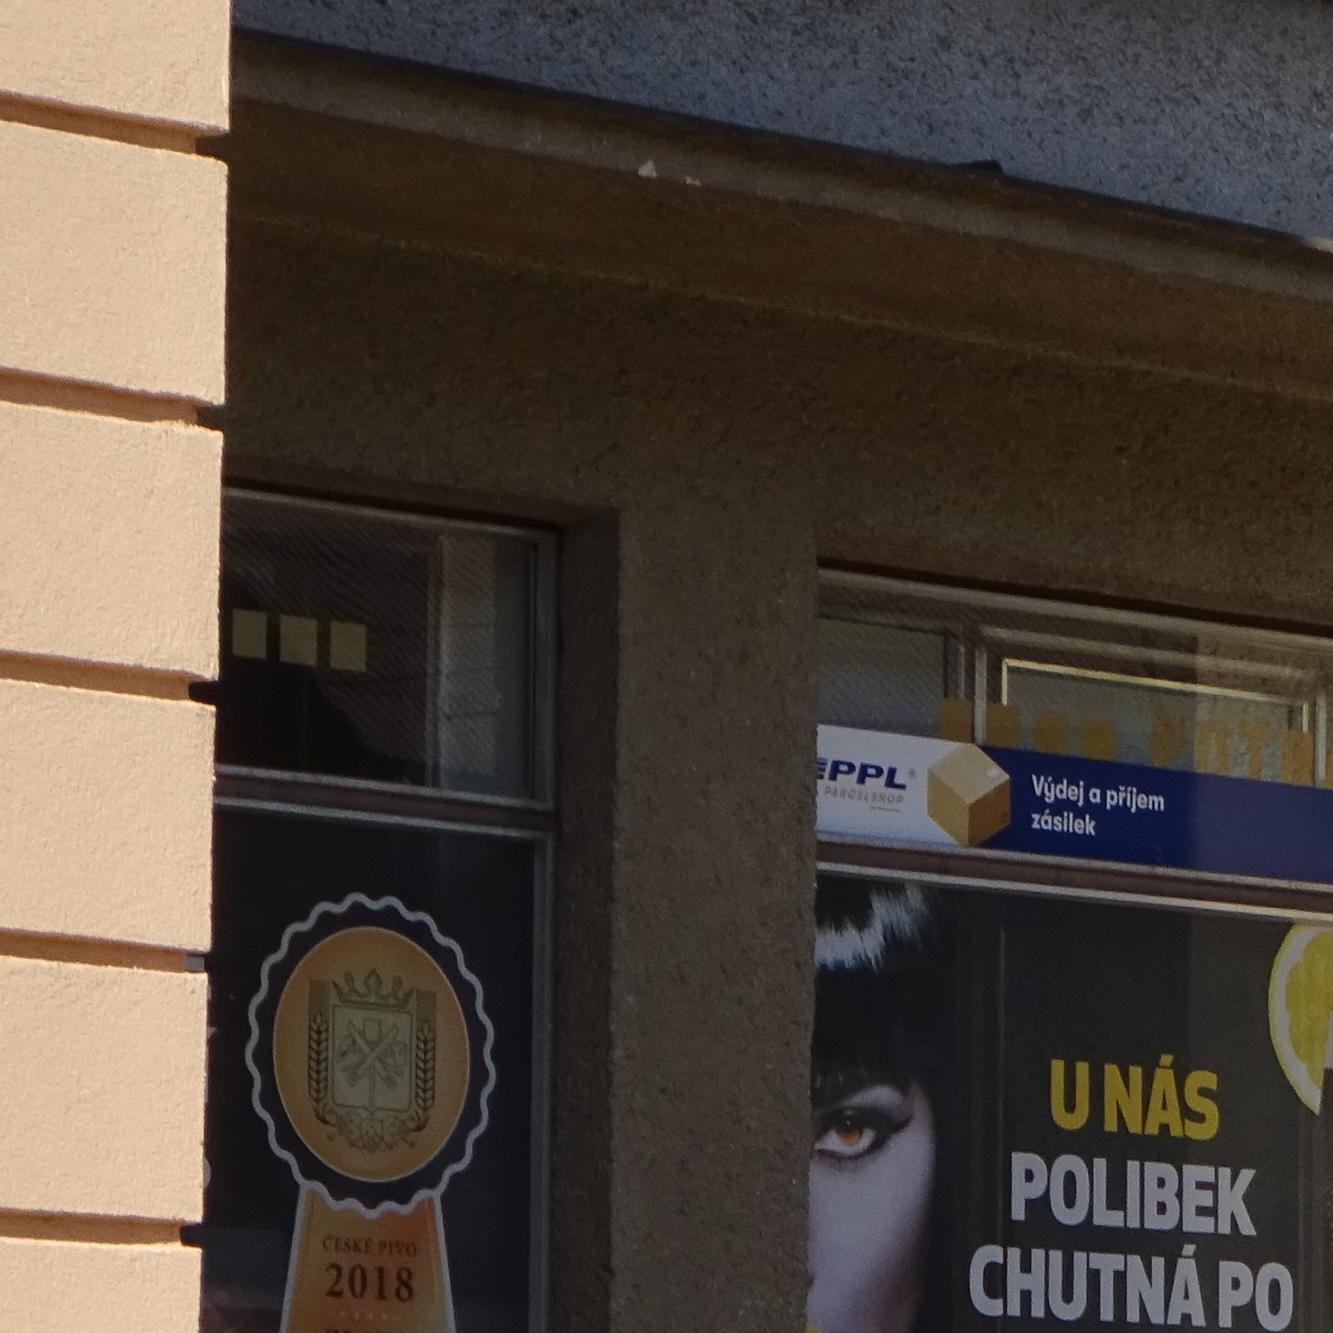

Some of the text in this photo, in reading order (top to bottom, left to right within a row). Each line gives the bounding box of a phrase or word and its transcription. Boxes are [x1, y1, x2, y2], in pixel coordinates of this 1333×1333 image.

[828, 759, 907, 791] PPL
[1031, 773, 1165, 813] Výdej a příjem
[1031, 808, 1096, 836] zásilek
[1050, 1054, 1220, 1140] U NÁS
[1010, 1151, 1257, 1236] POLIBEK
[325, 1262, 414, 1302] 2018
[968, 1243, 1294, 1332] CHUTNÁ PO
